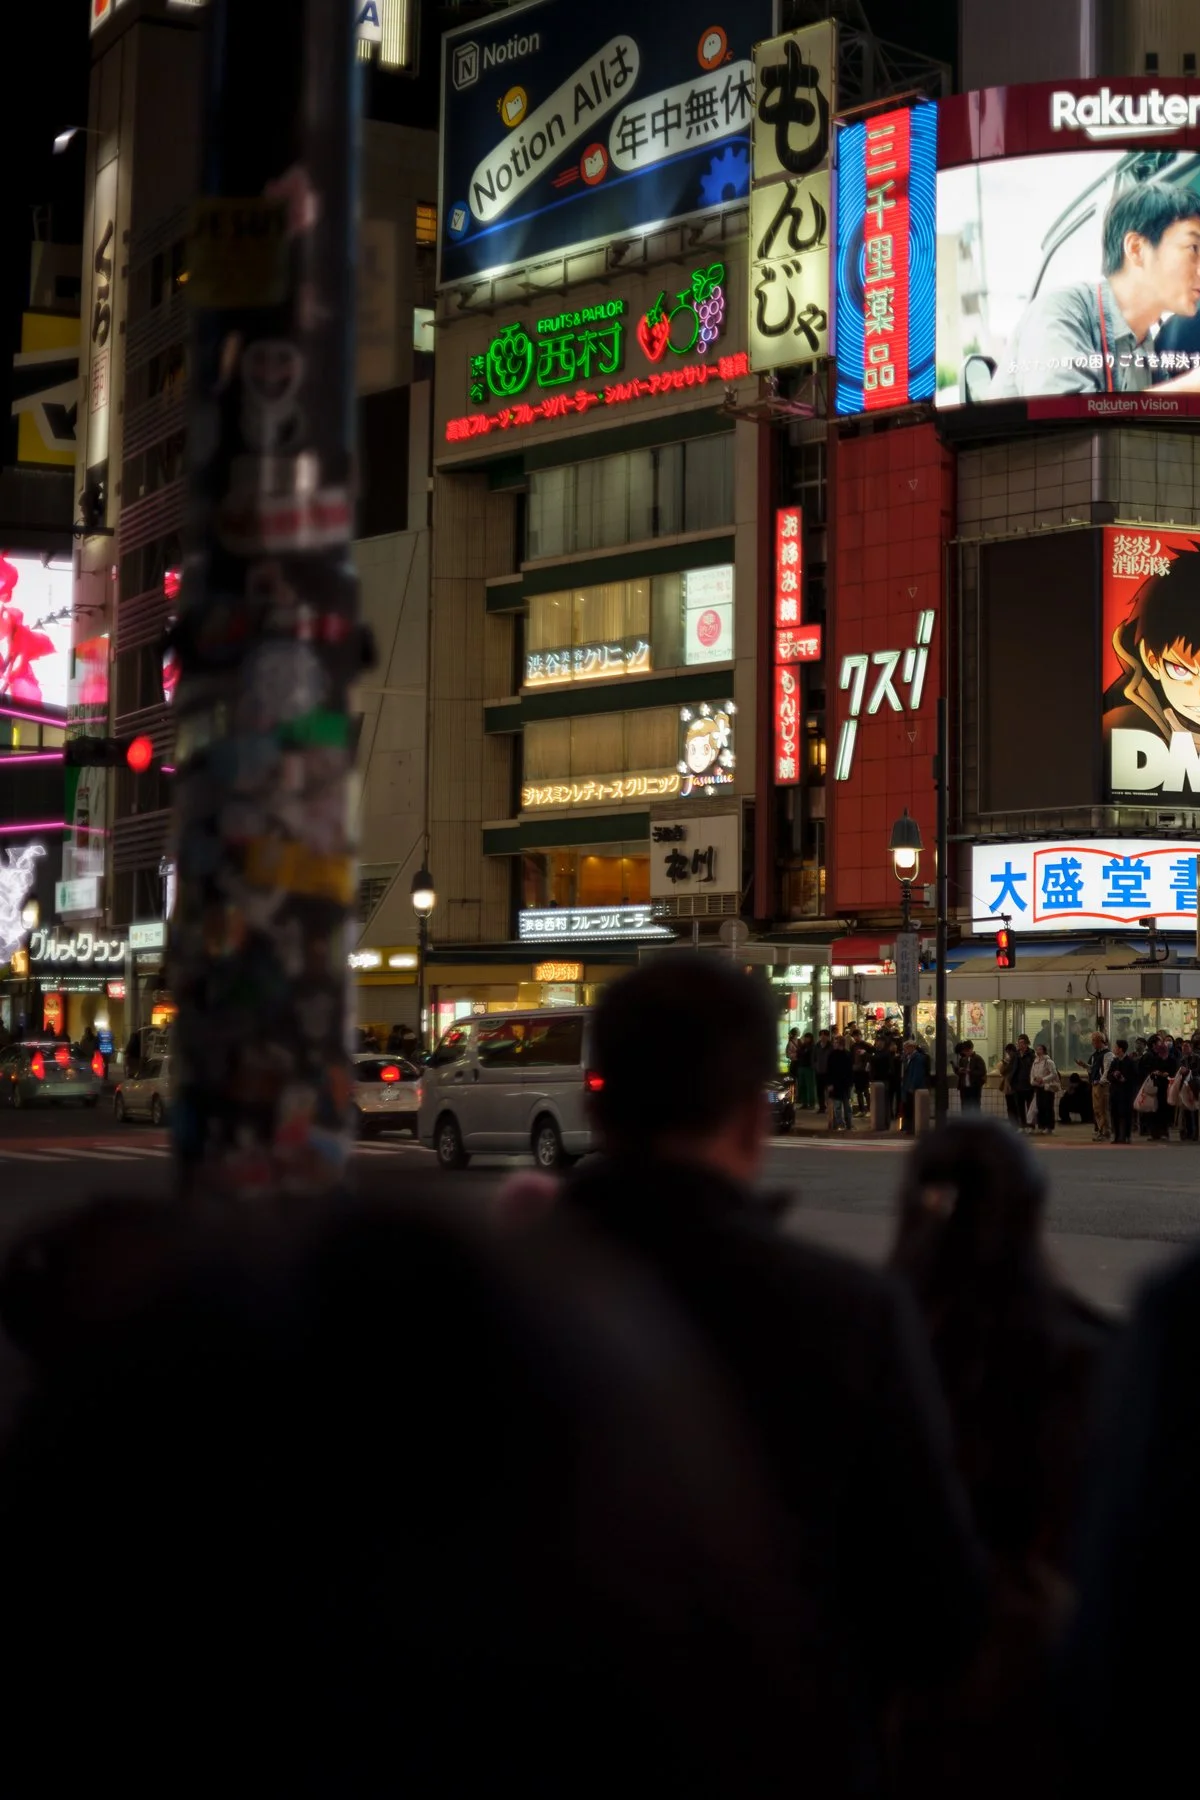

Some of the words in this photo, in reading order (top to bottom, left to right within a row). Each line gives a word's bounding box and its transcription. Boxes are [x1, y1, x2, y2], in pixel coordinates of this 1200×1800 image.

[483, 32, 540, 69] Notion
[615, 68, 757, 161] 年中無休
[474, 110, 567, 213] Notion
[757, 40, 828, 352] もんじゃ
[864, 124, 897, 391] 三千里薬品
[538, 322, 622, 387] 西村
[1087, 398, 1138, 414] Rakuten
[1140, 398, 1179, 412] Vision
[1111, 554, 1171, 577] 消防隊
[30, 929, 125, 962] グルメタウン
